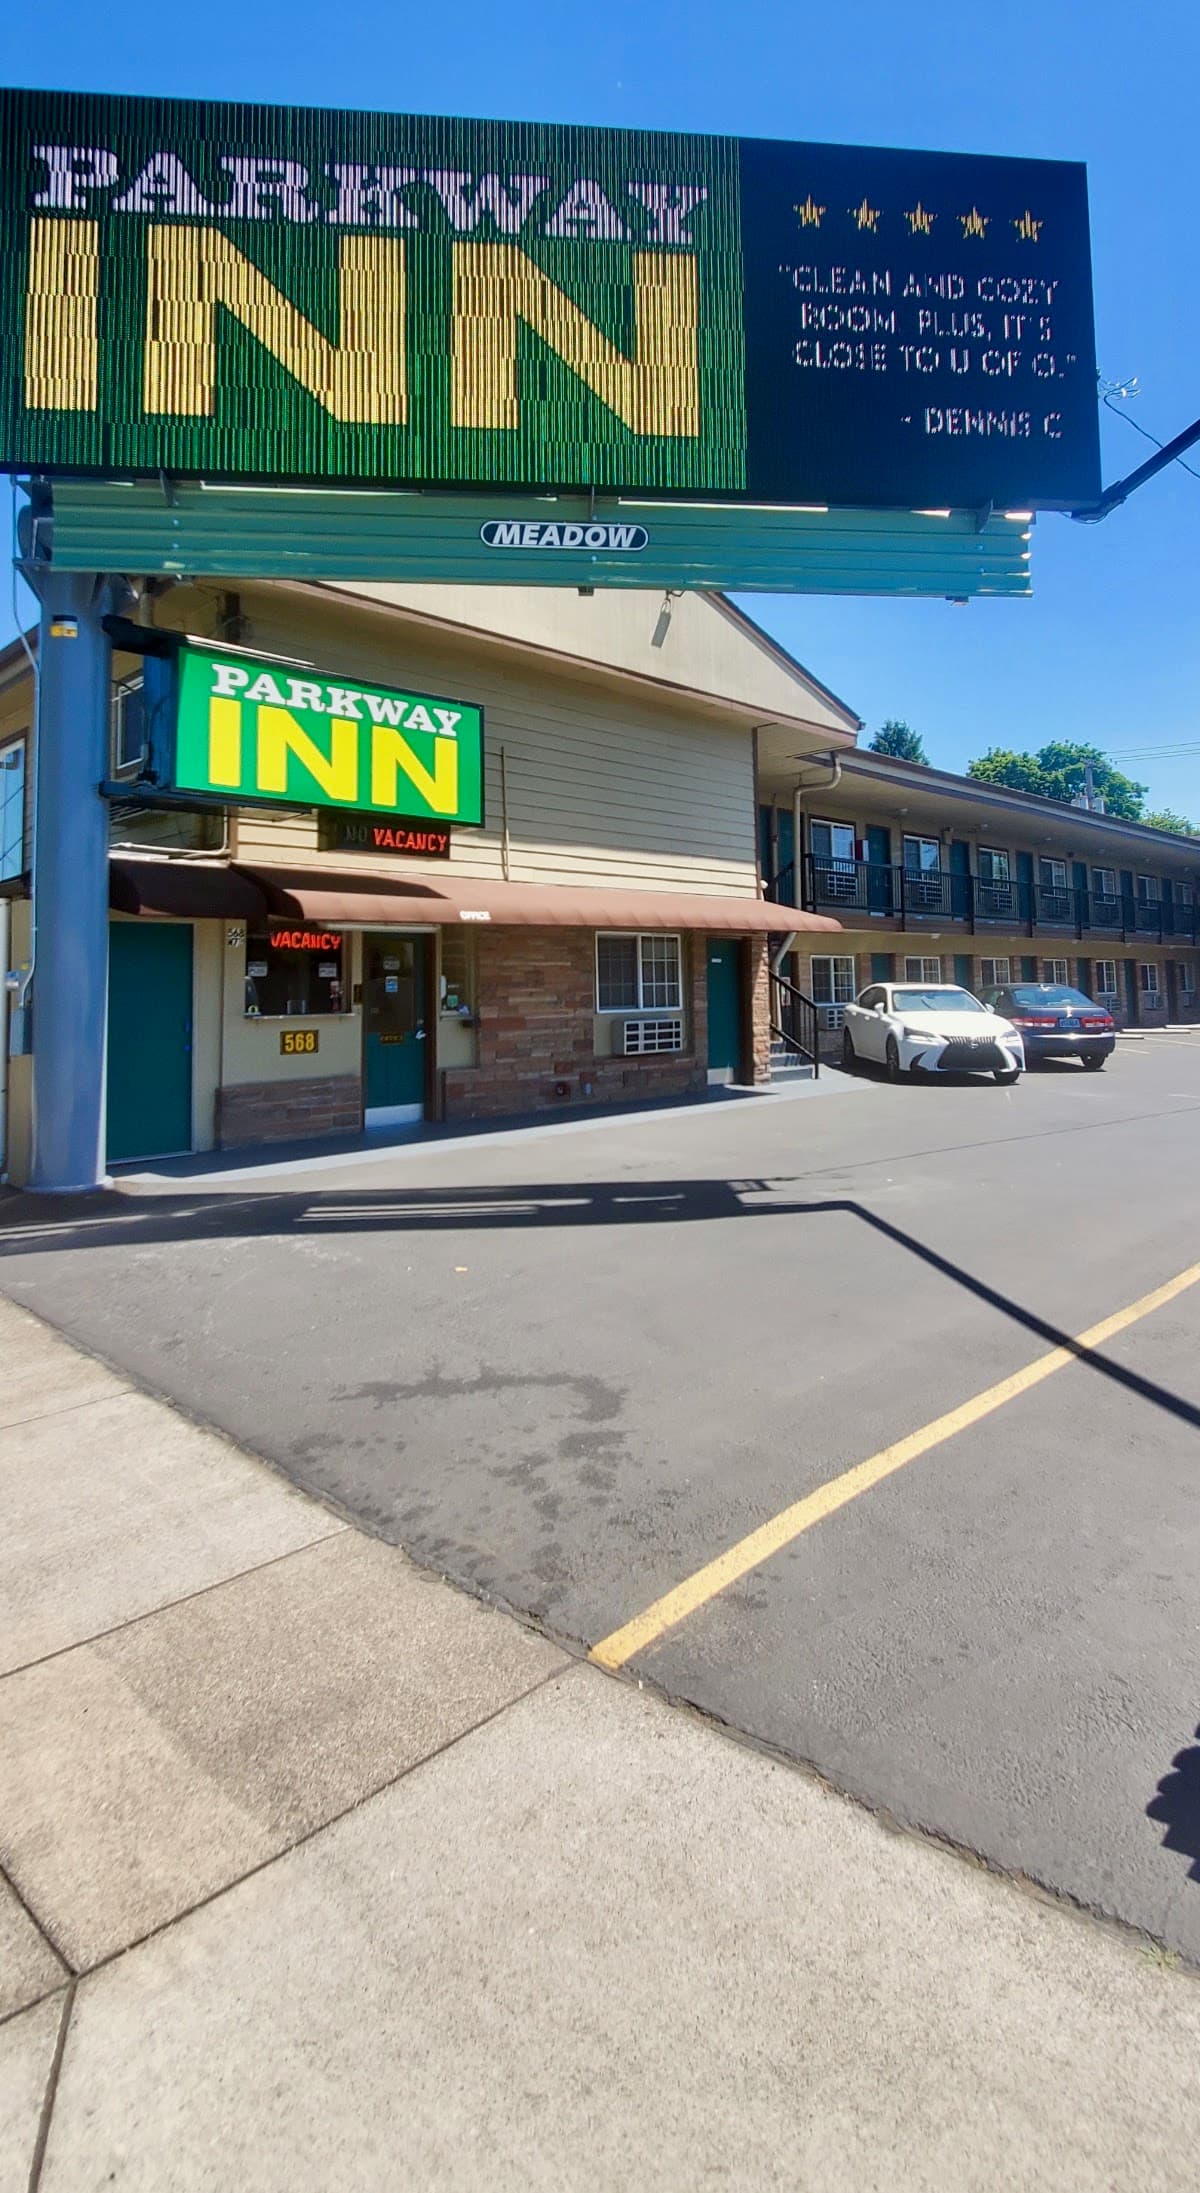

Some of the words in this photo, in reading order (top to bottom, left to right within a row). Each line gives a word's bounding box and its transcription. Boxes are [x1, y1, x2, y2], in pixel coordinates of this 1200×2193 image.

[34, 144, 708, 245] PARKWAY
[903, 271, 964, 300] AND
[977, 275, 1059, 305] COZY
[25, 217, 699, 437] INN
[919, 308, 991, 342] PLUS,
[1004, 313, 1051, 341] IT'S
[792, 340, 887, 370] CLOSE
[899, 344, 940, 373] TO
[950, 347, 969, 375] U
[982, 349, 1021, 377] OF
[925, 407, 1030, 438] DENNIS
[1044, 411, 1062, 439] C
[492, 524, 636, 548] MEADOW
[211, 663, 462, 737] PARKWAY
[208, 696, 458, 815] INN
[373, 827, 447, 852] VACANCY
[459, 909, 491, 921] OFFICE
[270, 930, 341, 950] VACANCY
[284, 1033, 314, 1052] 568
